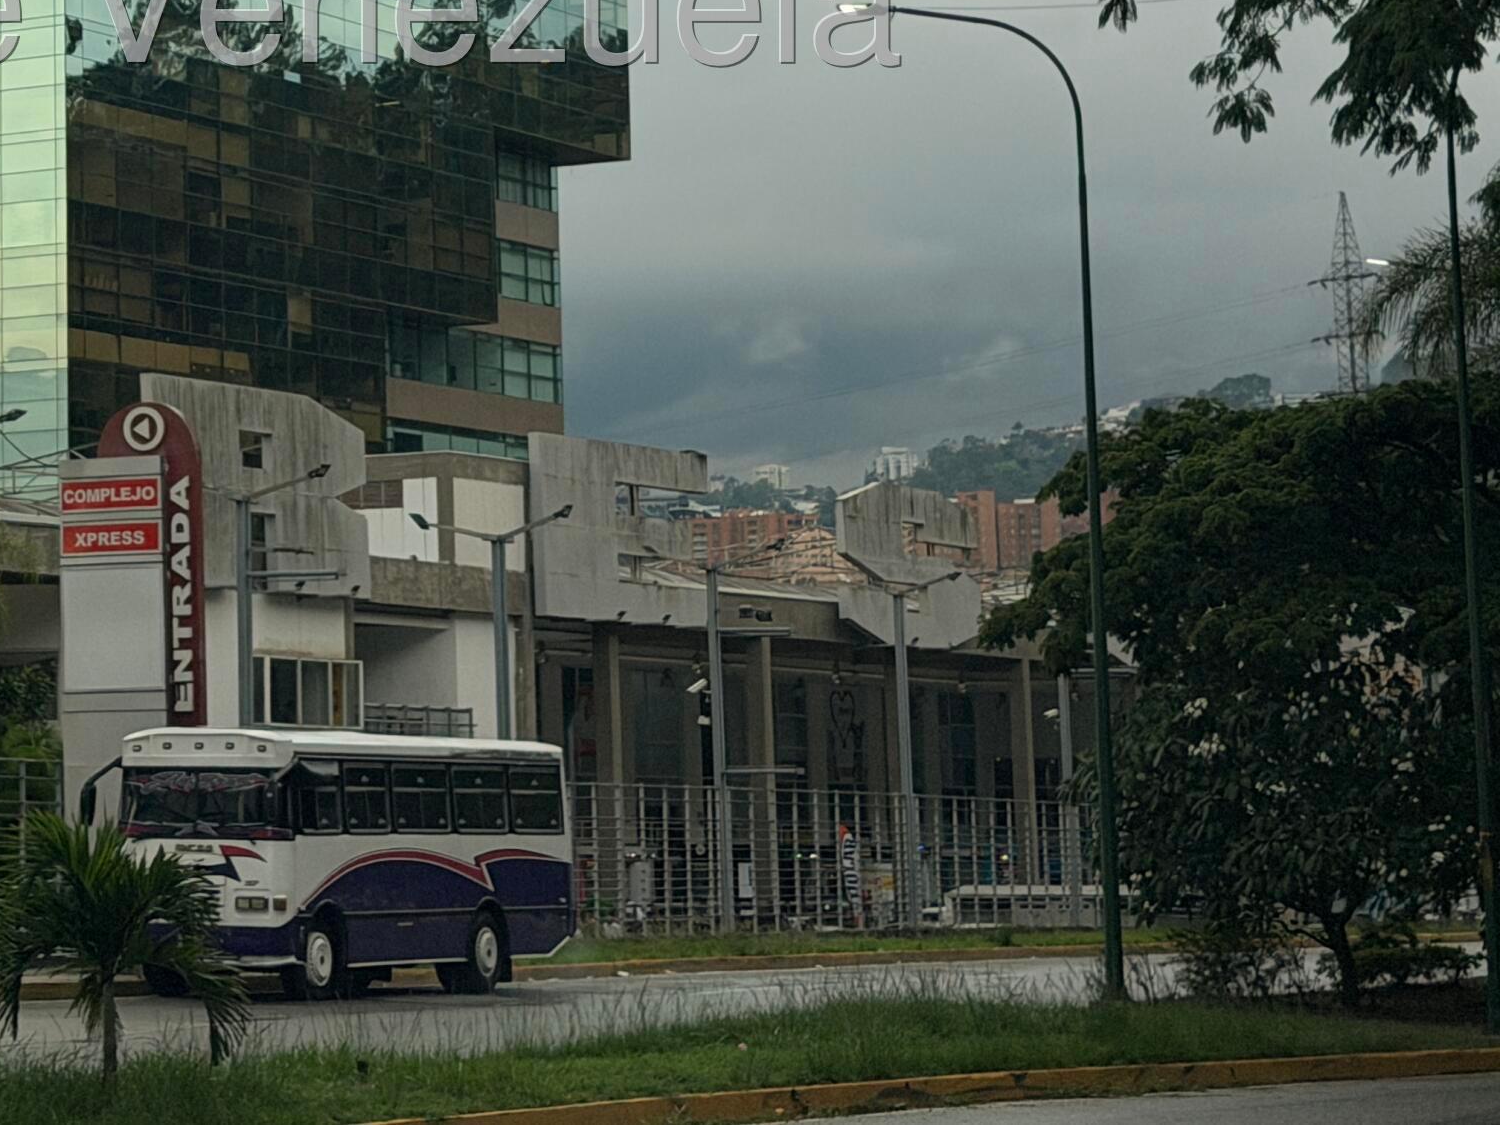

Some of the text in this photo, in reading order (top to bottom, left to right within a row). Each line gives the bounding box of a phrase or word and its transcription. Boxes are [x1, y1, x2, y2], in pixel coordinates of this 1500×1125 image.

[64, 486, 155, 504] COMPLEJO
[75, 531, 145, 547] XPRESS
[169, 475, 194, 713] ENTRADA
